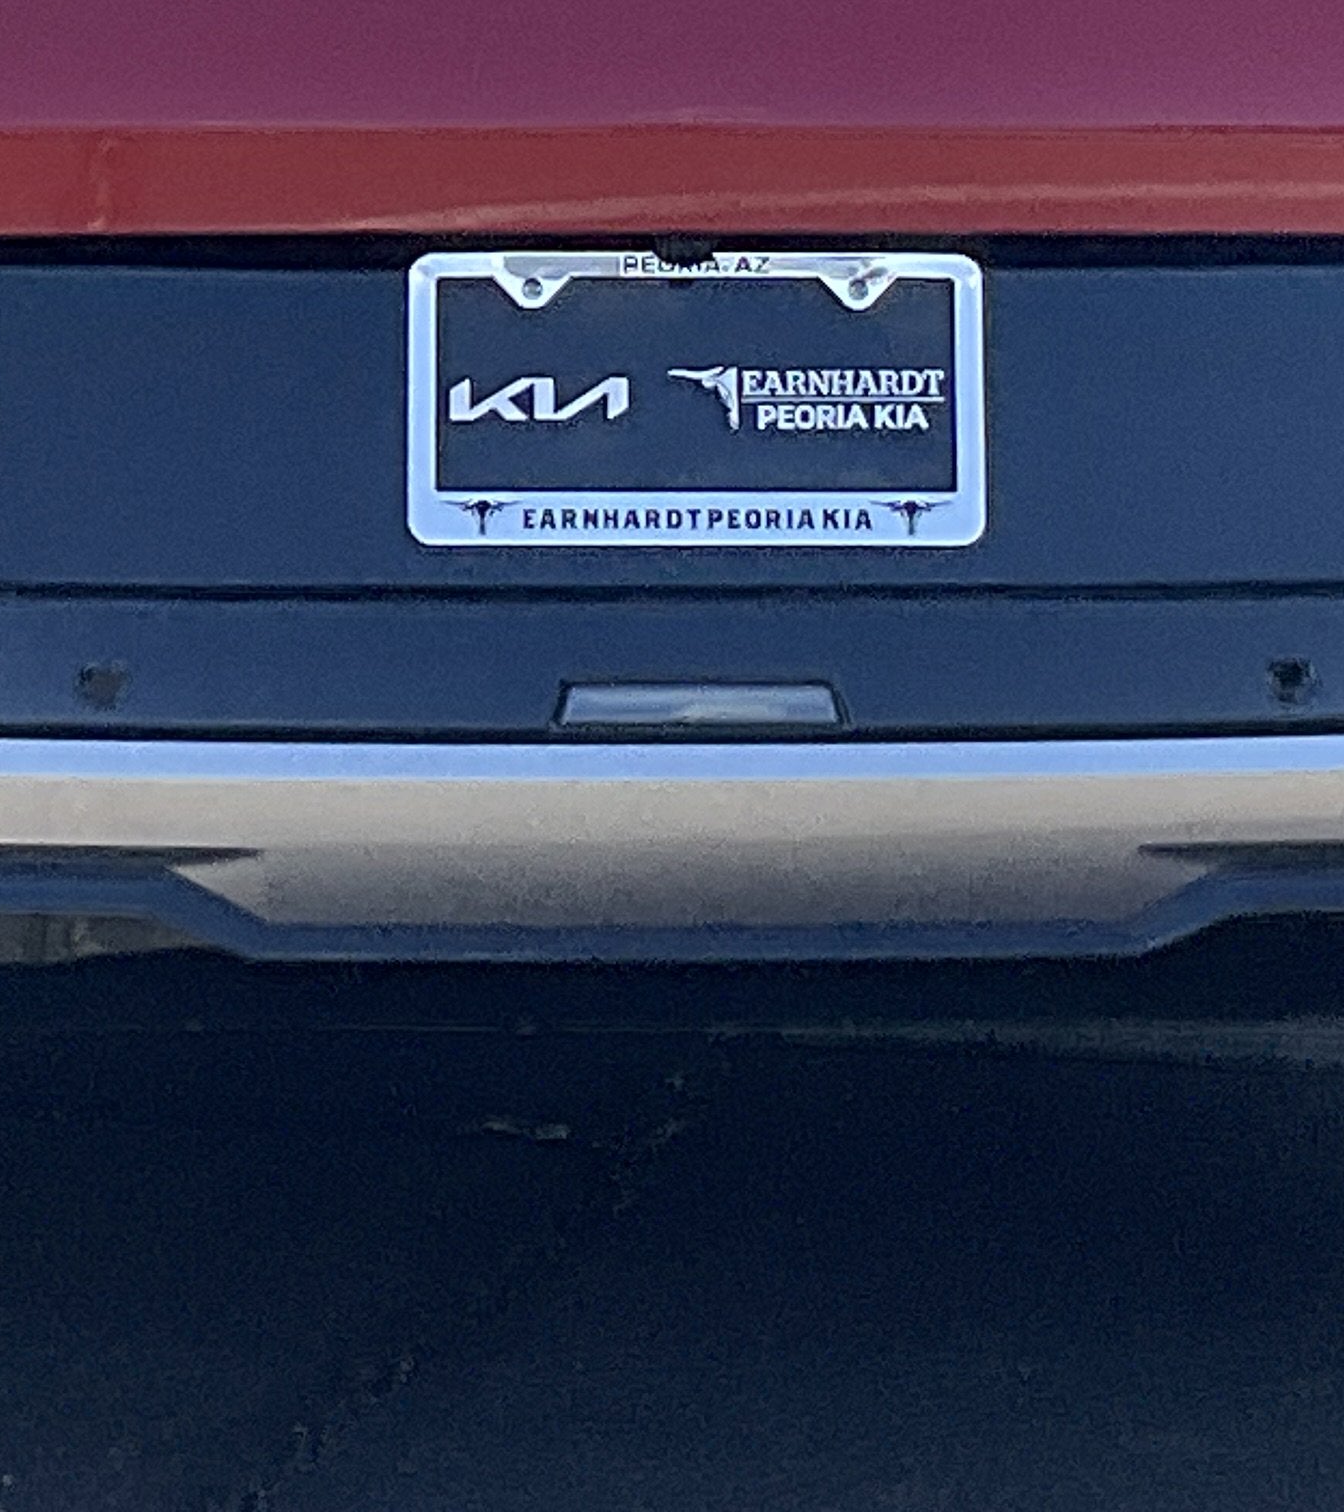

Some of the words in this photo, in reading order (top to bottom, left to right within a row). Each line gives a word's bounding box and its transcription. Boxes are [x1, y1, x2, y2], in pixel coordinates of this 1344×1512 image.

[735, 256, 771, 274] AZ
[741, 368, 945, 397] EARNHARDT
[449, 375, 630, 421] KIA
[757, 405, 867, 431] PEORIA
[874, 405, 930, 430] KIA
